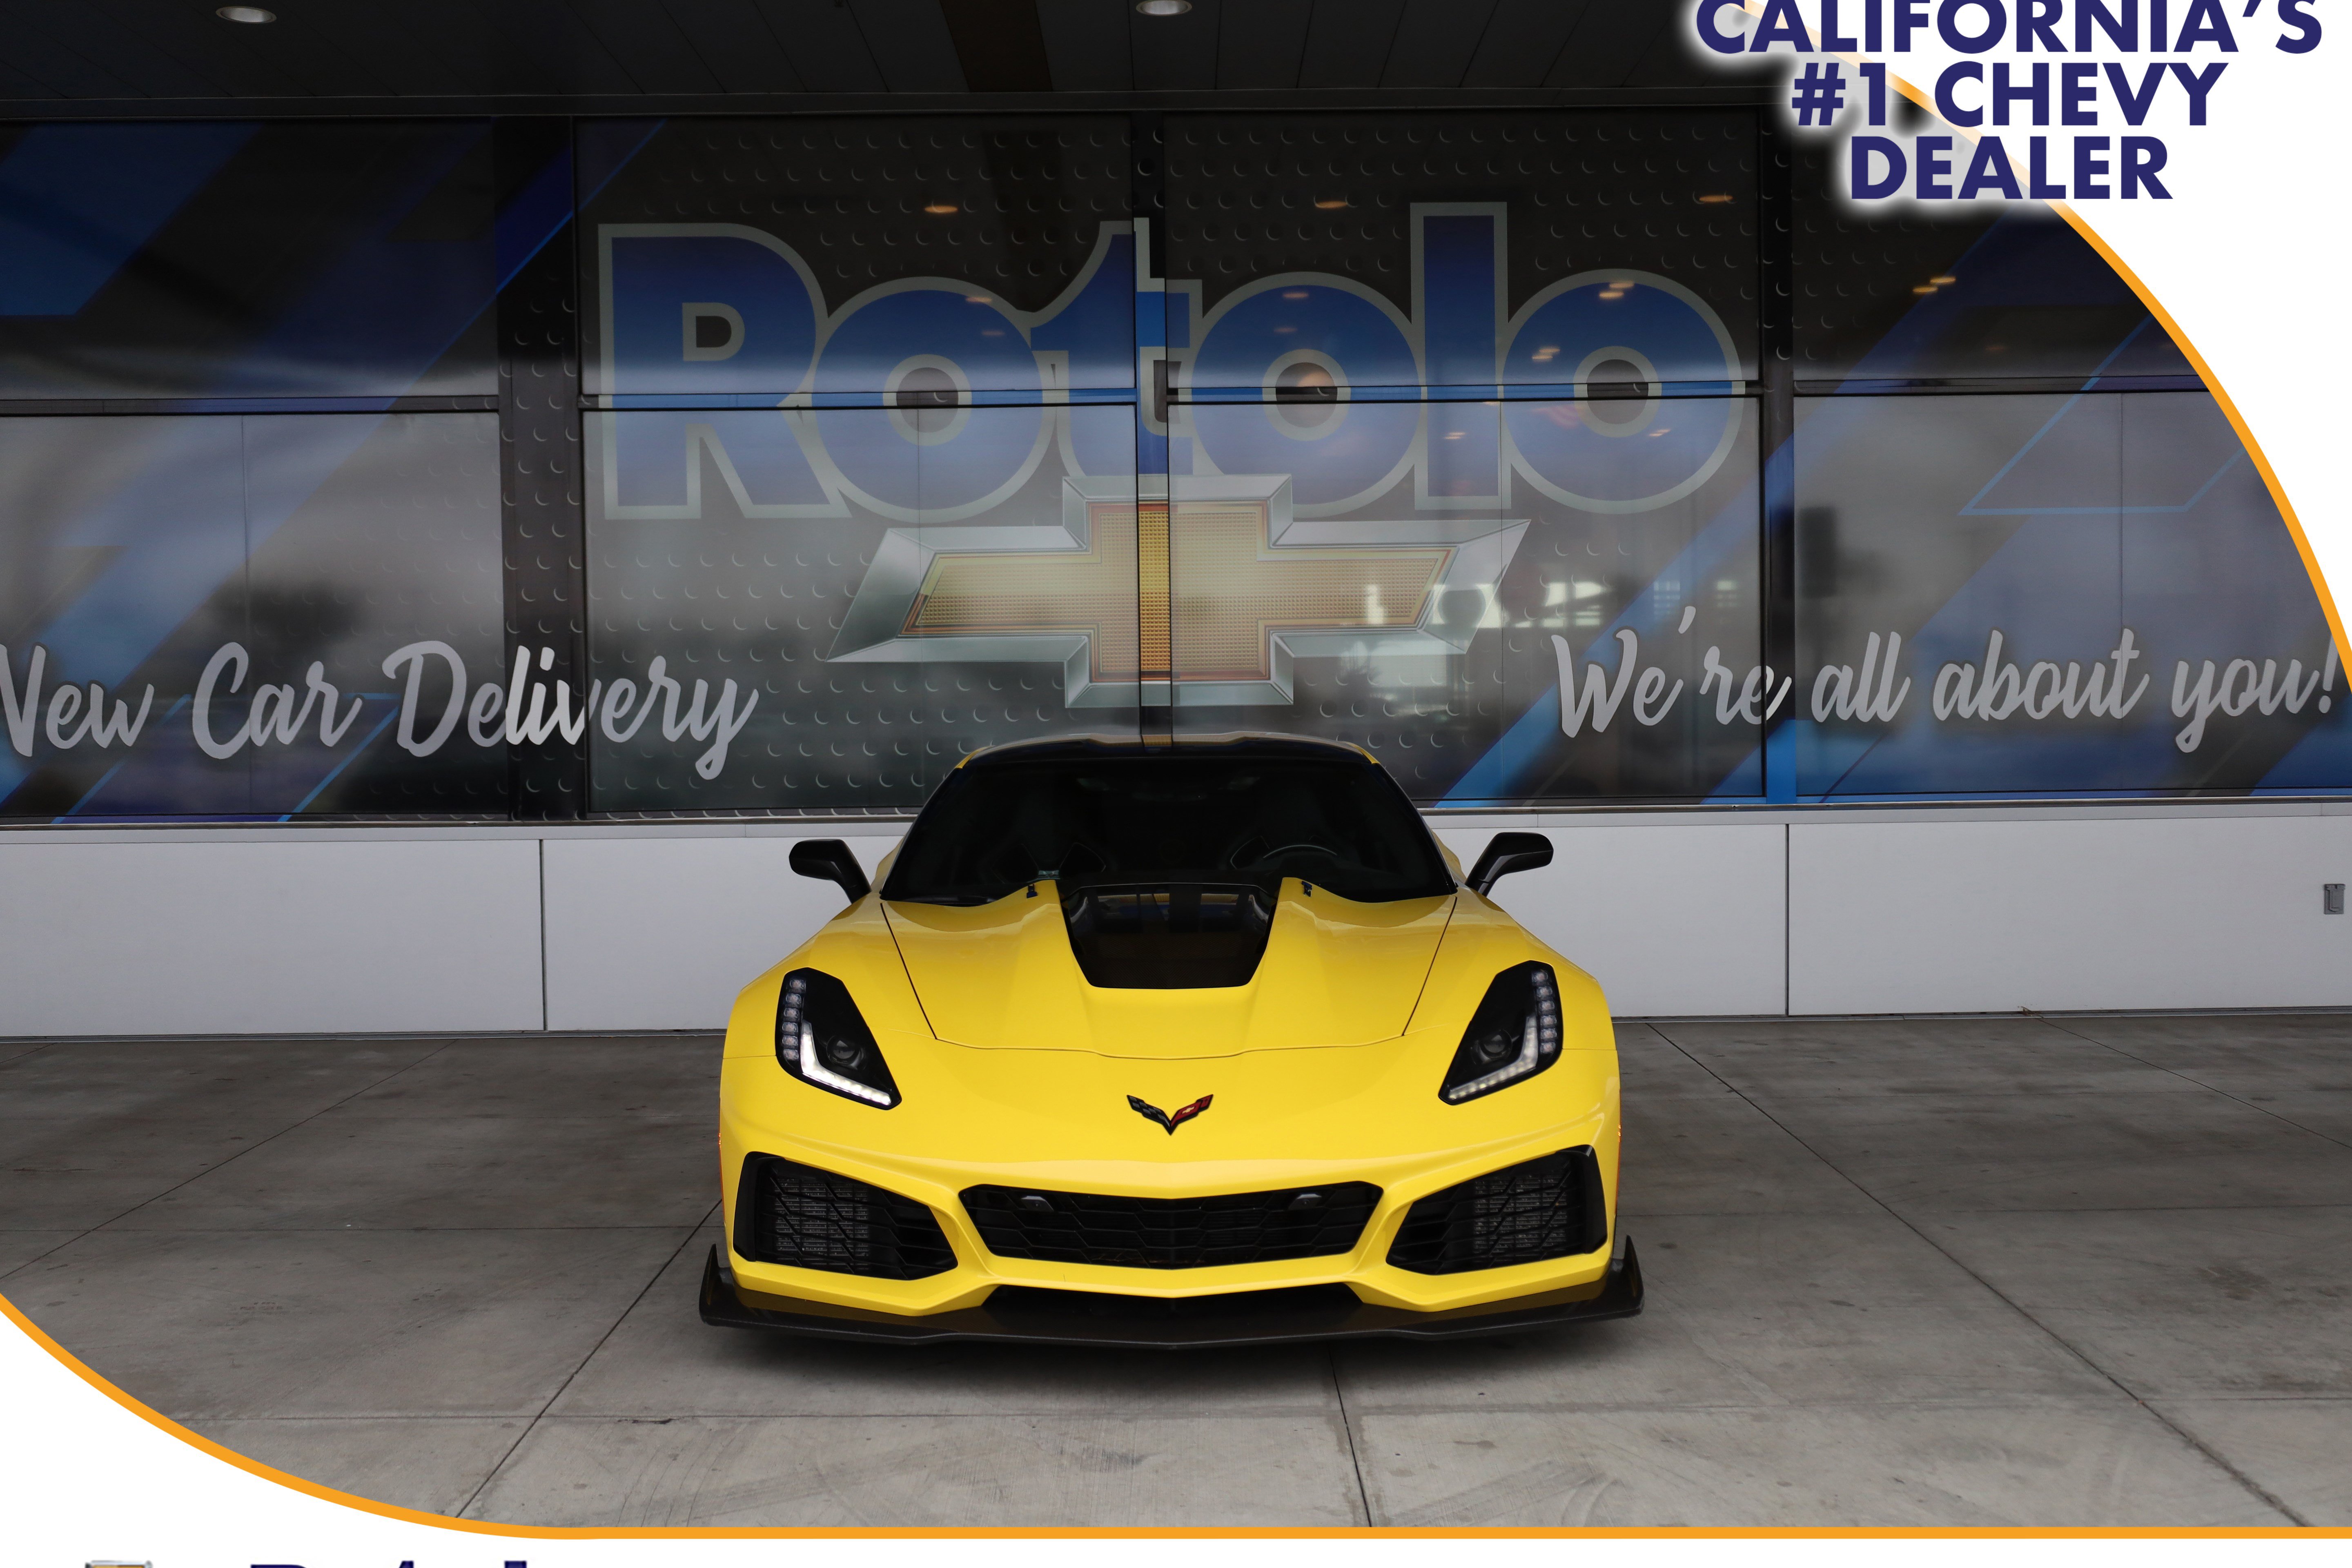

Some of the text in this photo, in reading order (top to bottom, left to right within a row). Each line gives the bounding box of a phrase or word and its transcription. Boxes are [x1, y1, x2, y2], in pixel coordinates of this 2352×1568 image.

[599, 203, 1745, 520] Rotolo
[193, 641, 363, 760] Car
[382, 640, 759, 781] Delivery
[1551, 606, 2339, 753] We're all about you!
